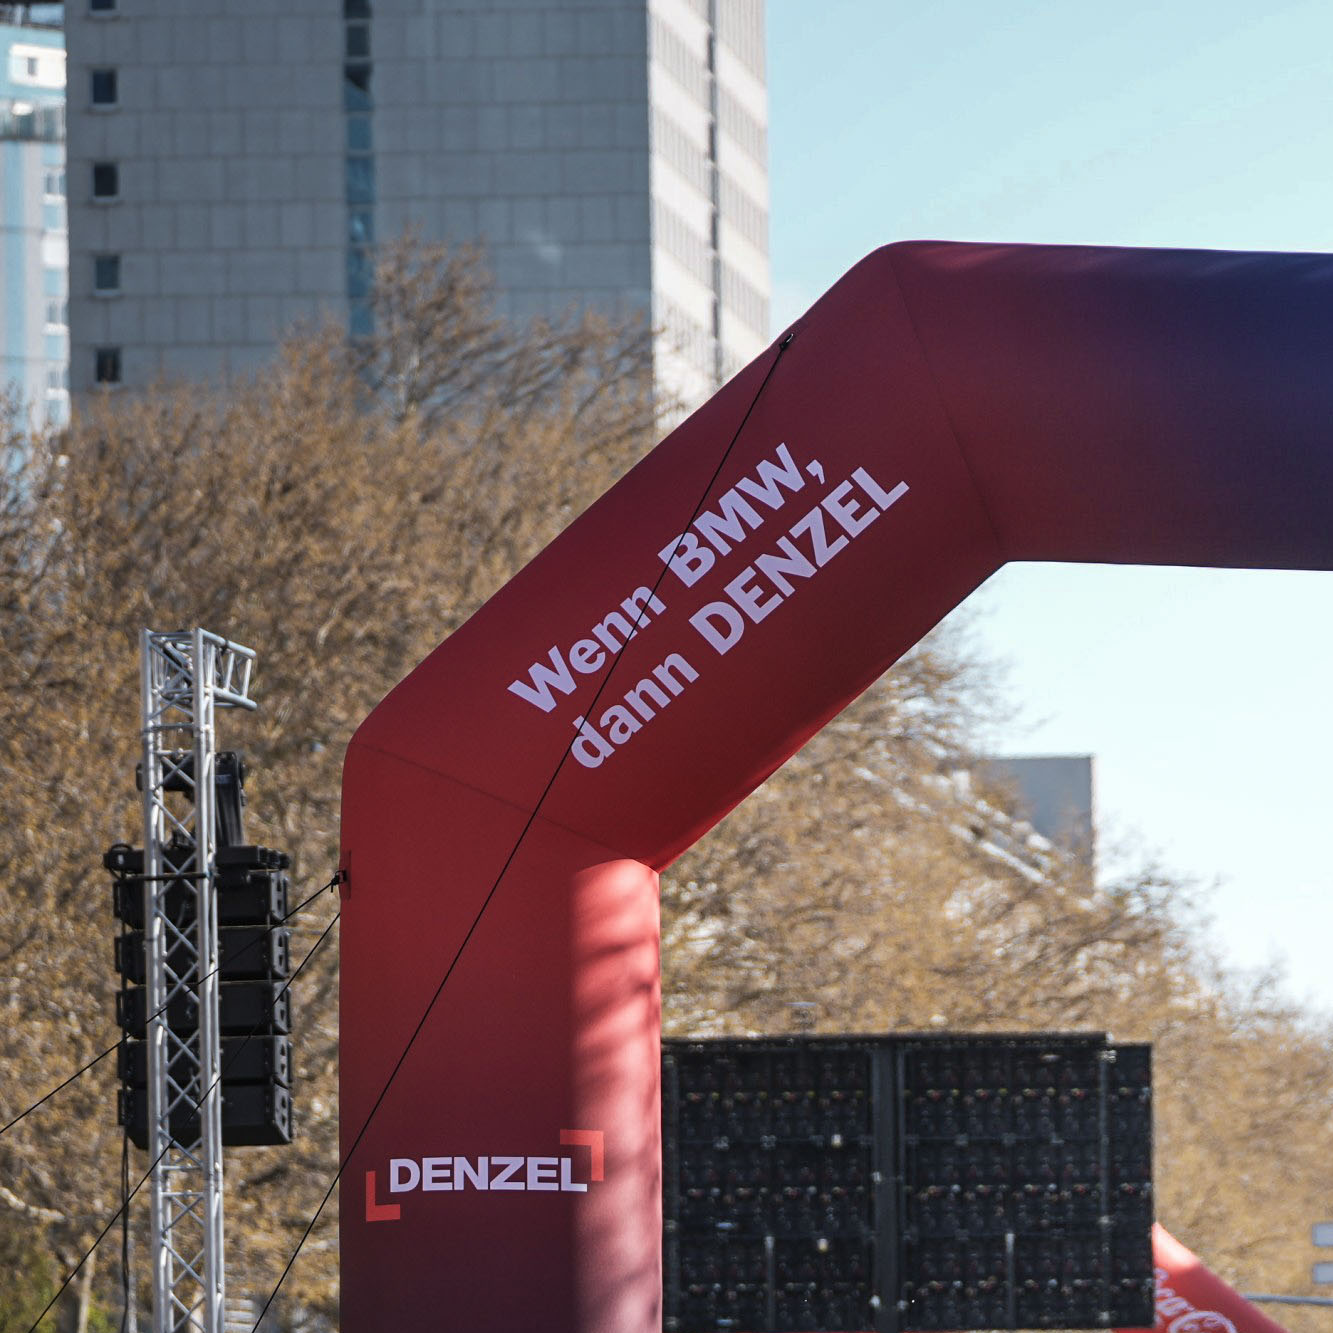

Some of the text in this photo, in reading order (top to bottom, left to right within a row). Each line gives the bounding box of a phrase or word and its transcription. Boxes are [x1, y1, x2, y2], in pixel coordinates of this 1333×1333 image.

[507, 442, 826, 713] Wenn BMW,
[570, 466, 910, 769] dann DENZEL
[389, 1156, 588, 1193] DENZEL
